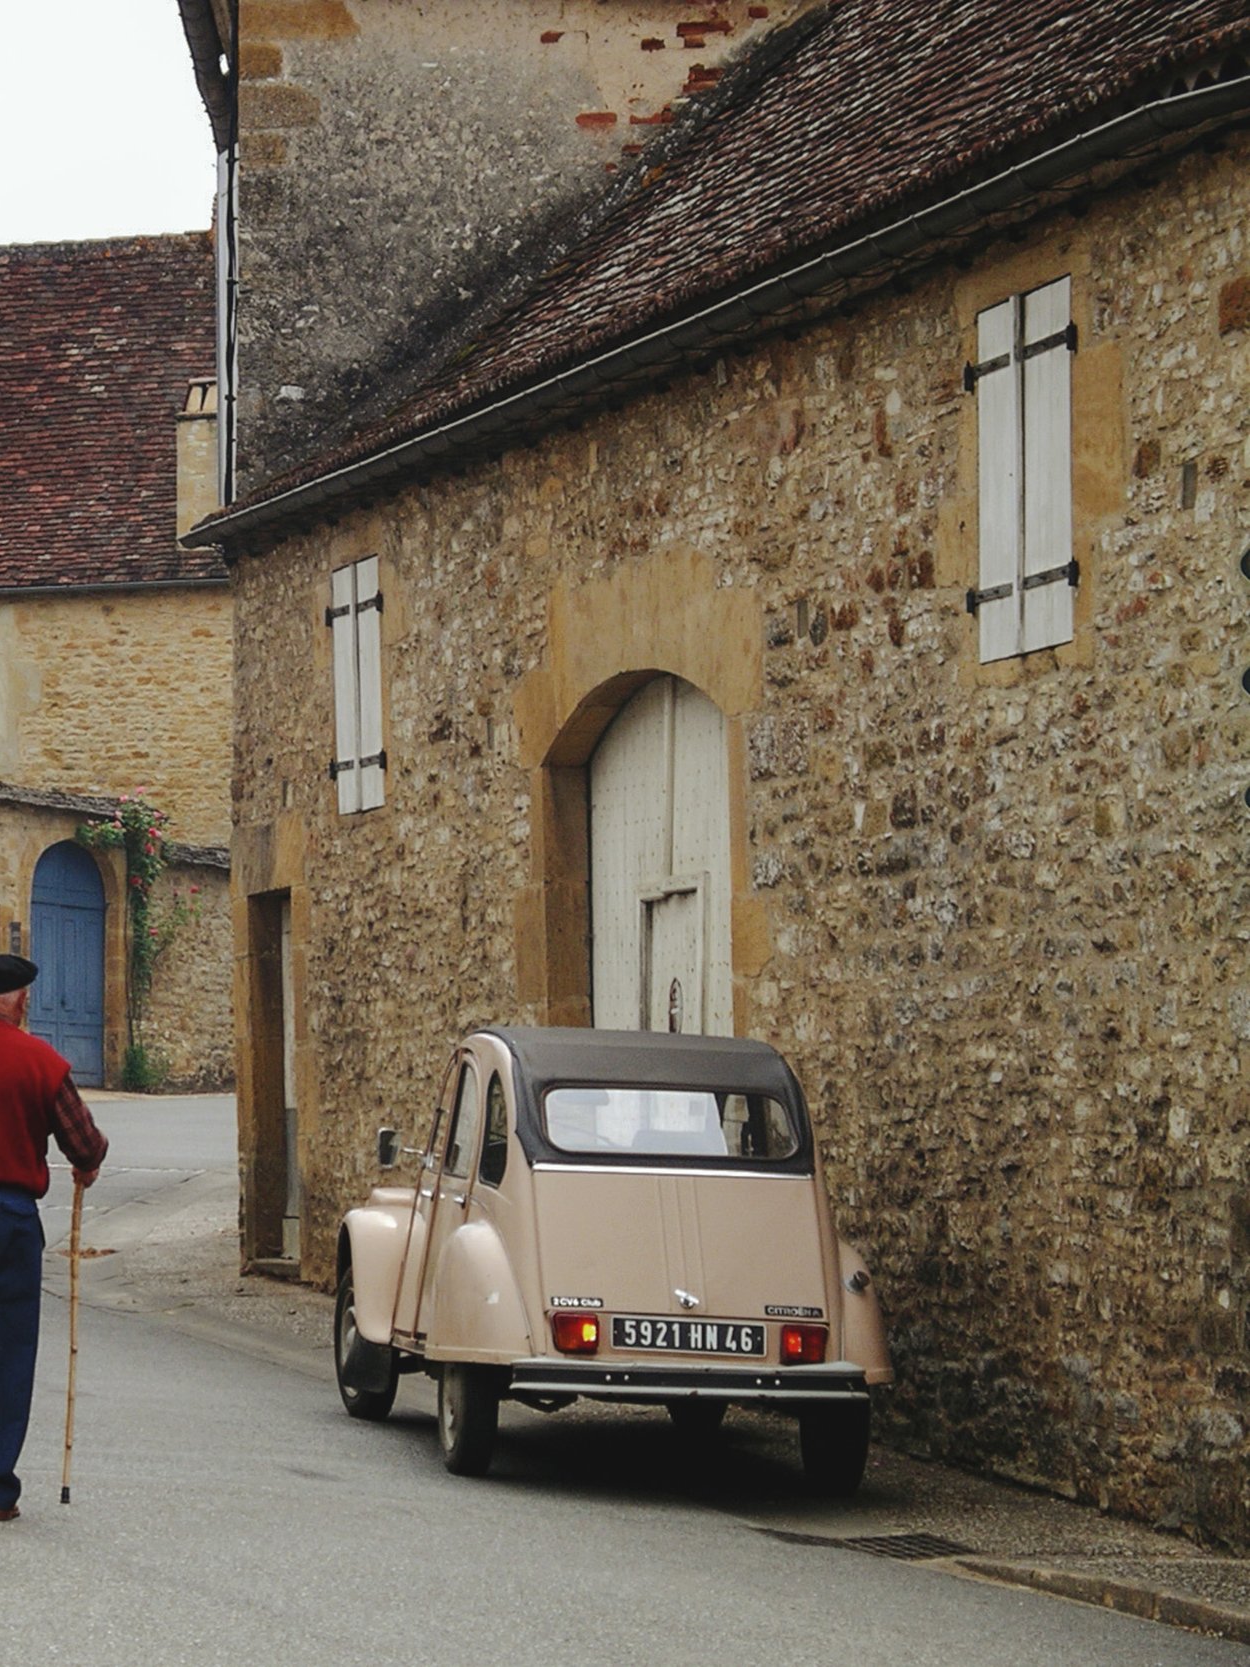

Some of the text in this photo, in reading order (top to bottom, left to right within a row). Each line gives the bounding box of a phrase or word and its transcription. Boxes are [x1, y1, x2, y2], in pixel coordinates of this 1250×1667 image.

[553, 1296, 601, 1307] 2CV6 Club
[624, 1320, 753, 1352] 5921 HN 46
